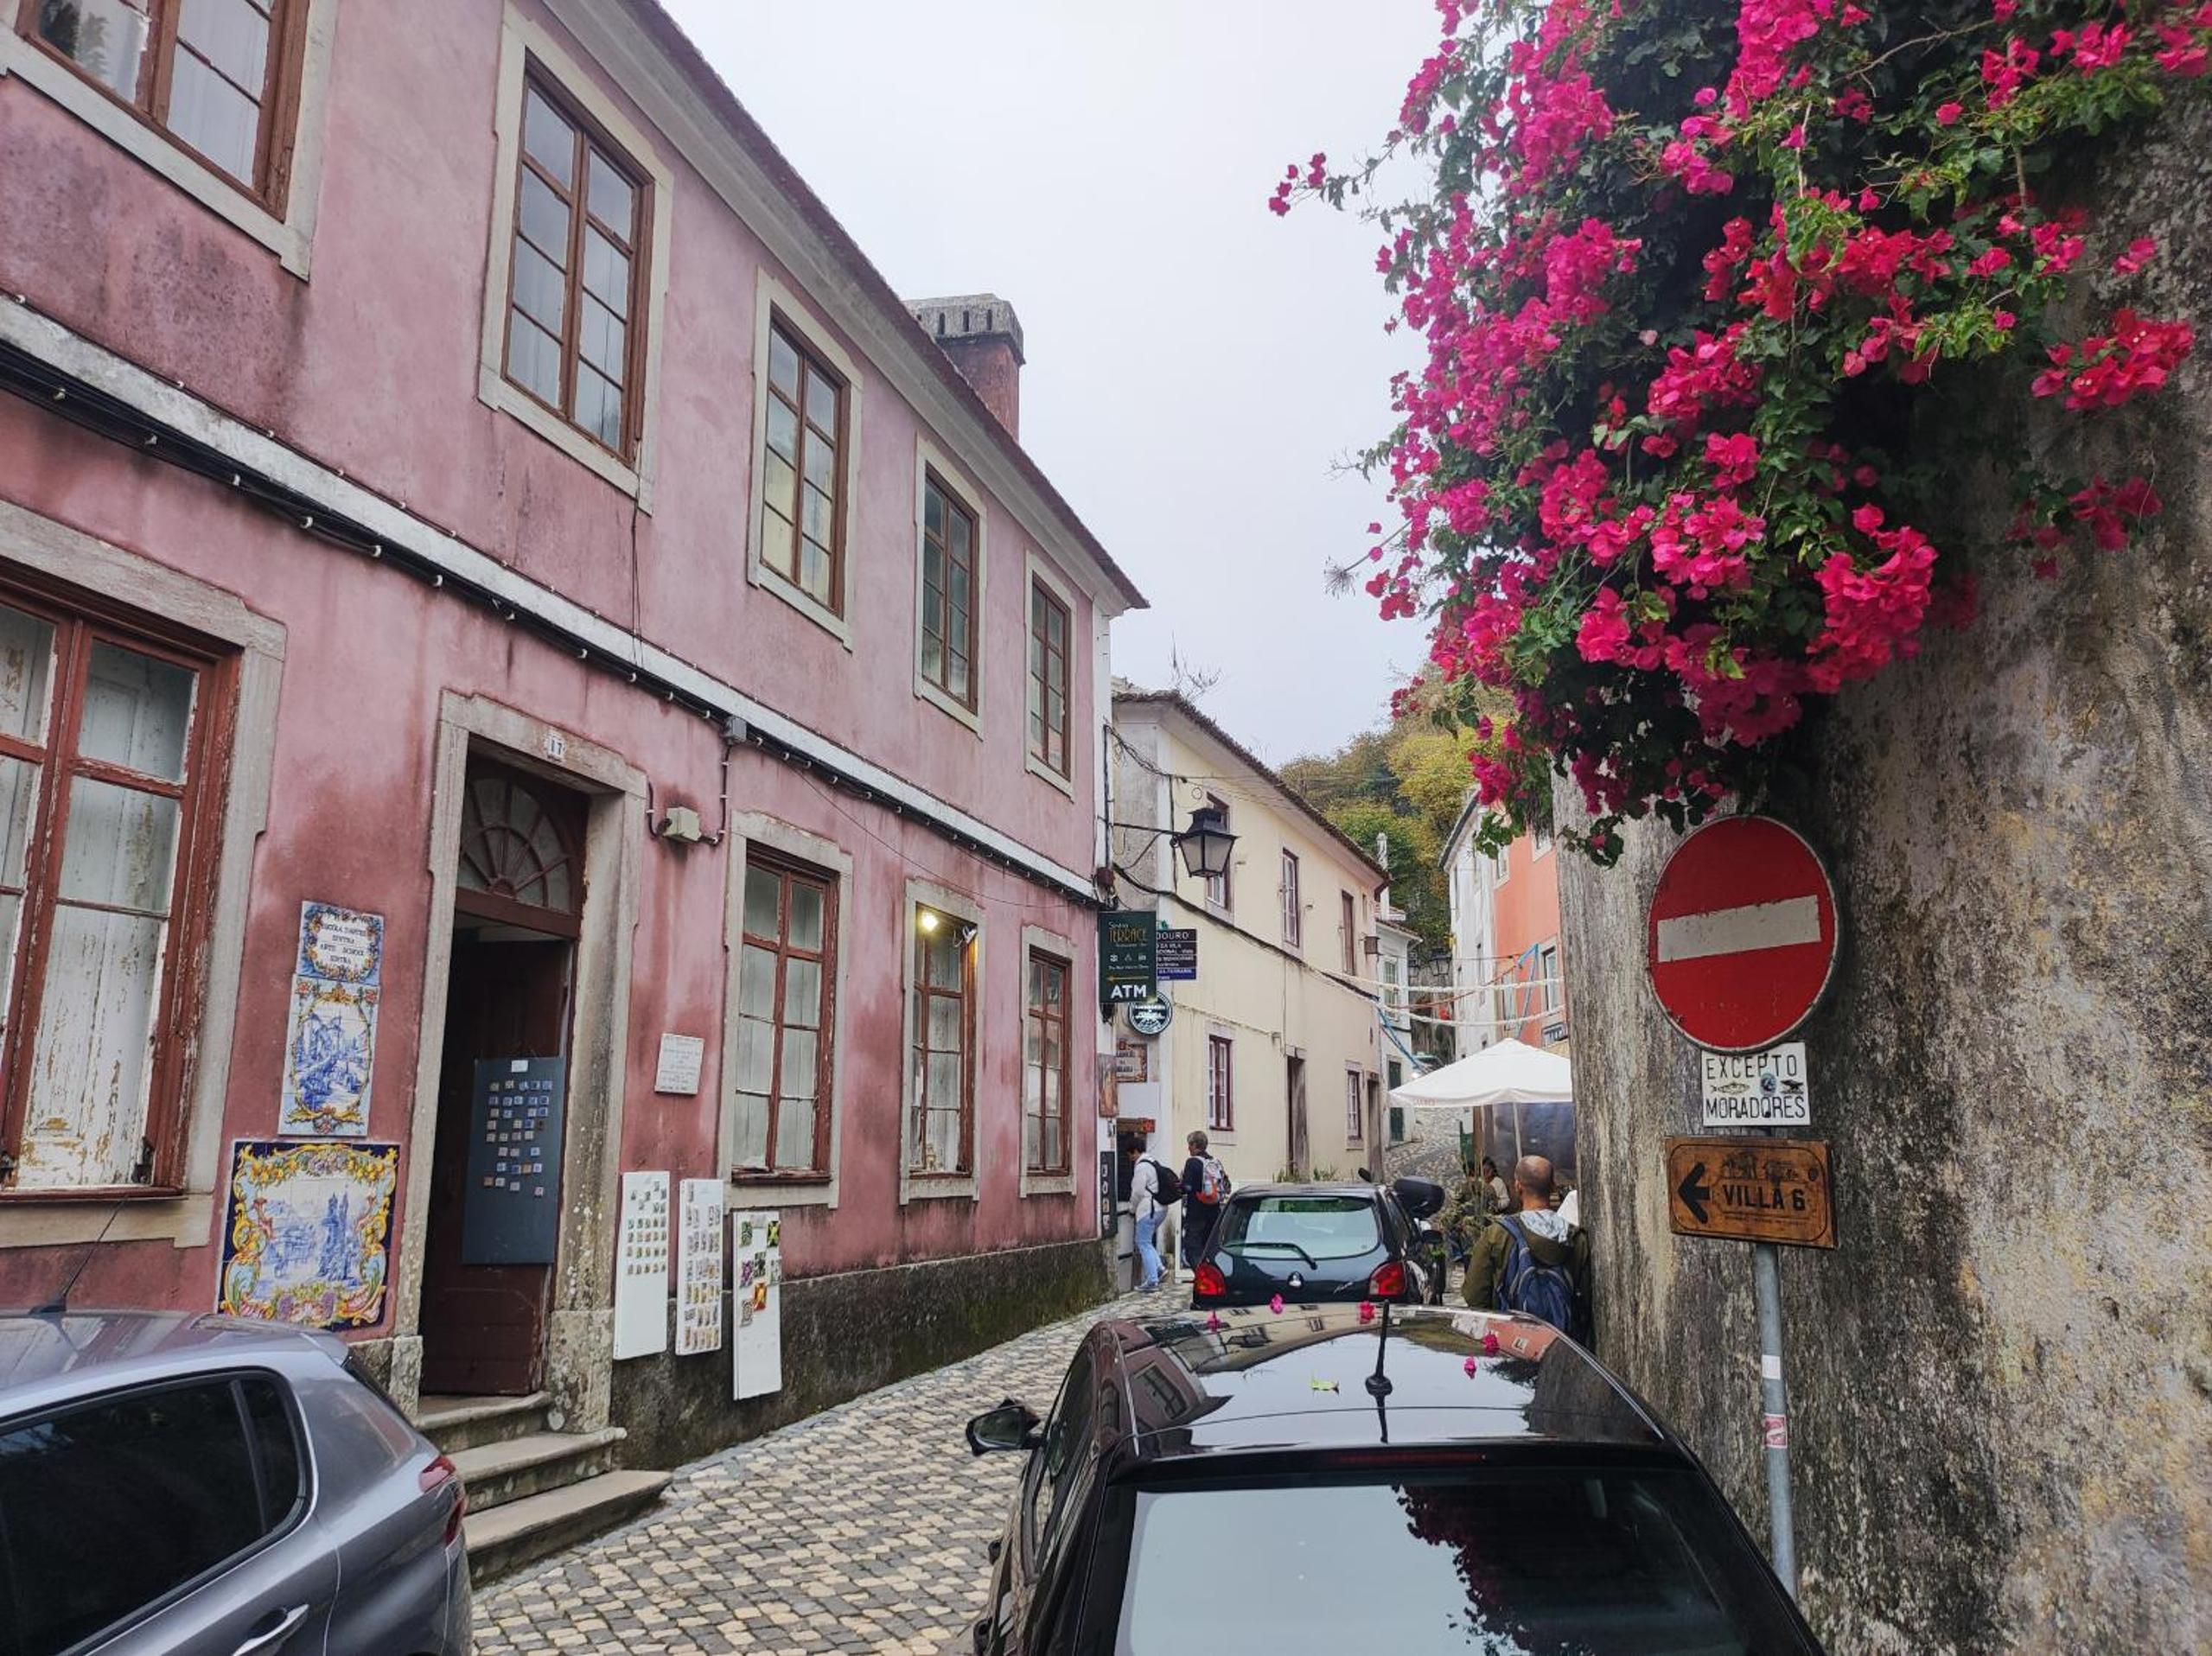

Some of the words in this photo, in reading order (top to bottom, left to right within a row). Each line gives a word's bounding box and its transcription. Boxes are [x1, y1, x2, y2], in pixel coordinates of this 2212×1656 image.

[1110, 984, 1147, 998] ATM
[1705, 1054, 1798, 1080] EXCEPTO
[1705, 1095, 1806, 1118] MORADORES
[1722, 1184, 1785, 1210] VILLA
[1792, 1188, 1806, 1211] 6
